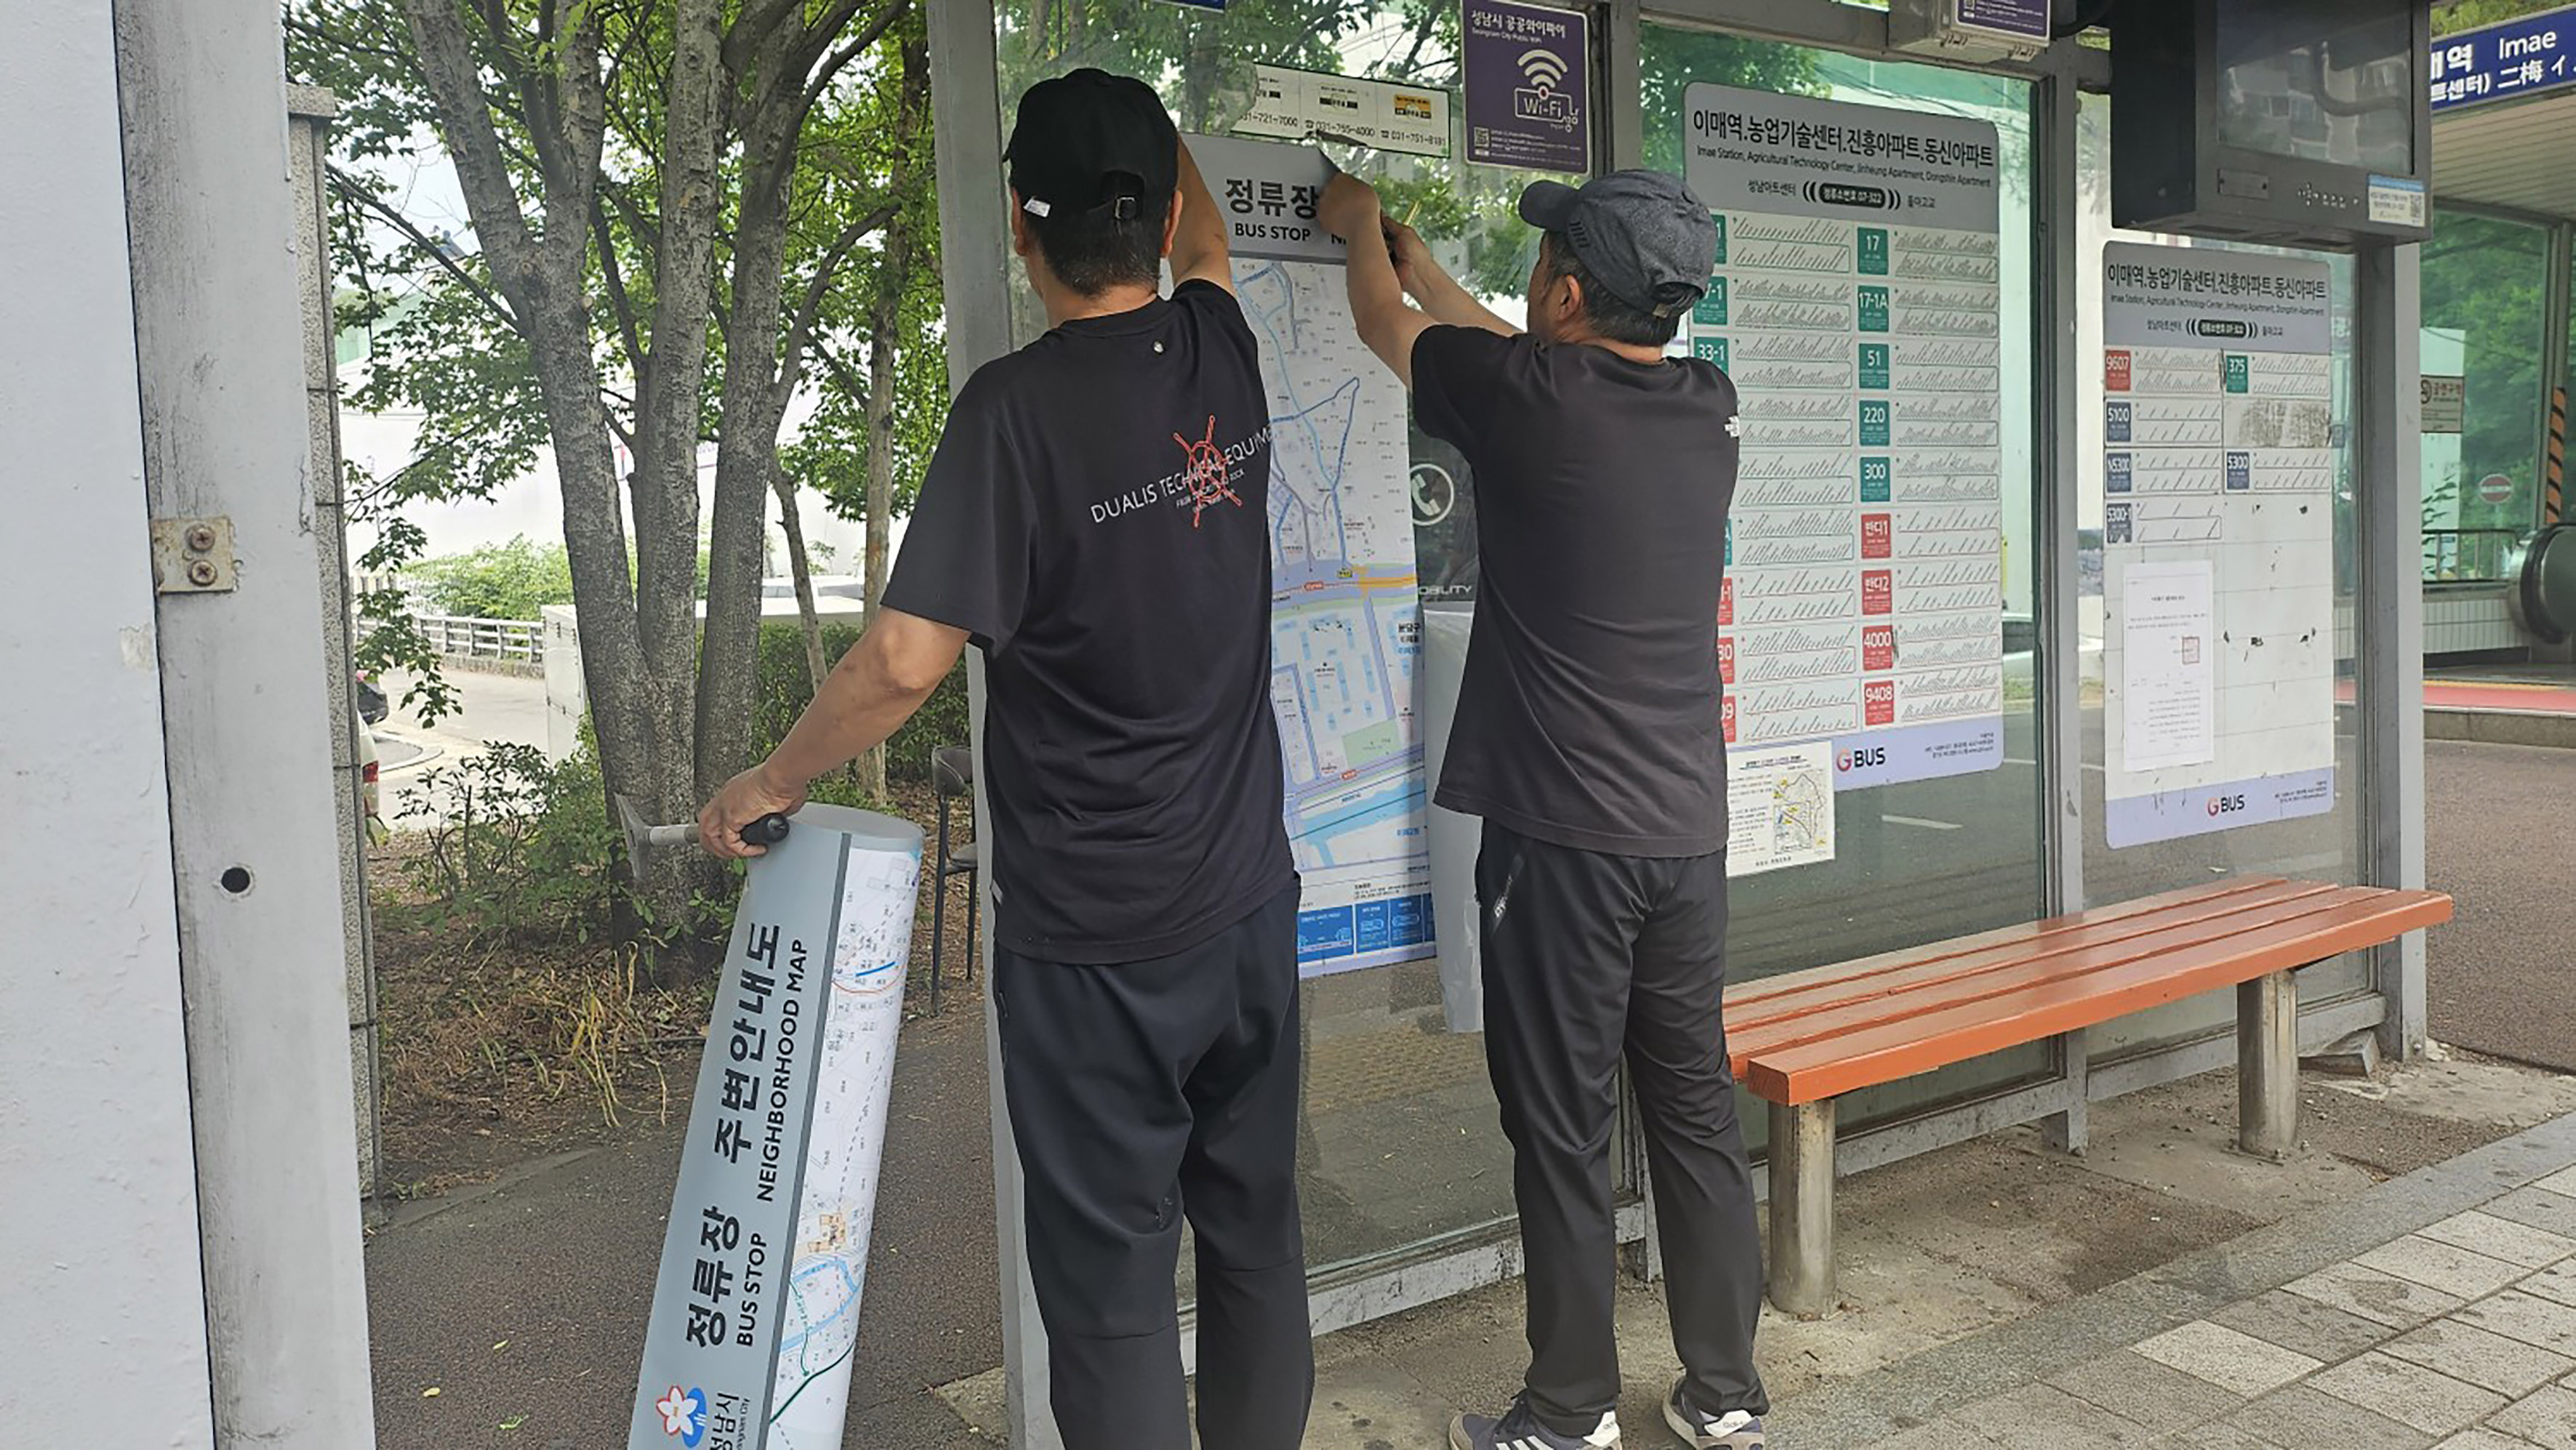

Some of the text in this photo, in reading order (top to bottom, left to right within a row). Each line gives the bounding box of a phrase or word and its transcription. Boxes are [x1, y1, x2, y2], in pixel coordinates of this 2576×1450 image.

[1472, 9, 1566, 39] 성남시 공공와이파이
[2499, 31, 2557, 60] Imae
[2497, 59, 2543, 89] 二梅
[2431, 73, 2490, 102] 트센터)
[1523, 97, 1562, 118] Wi-Fi
[1225, 179, 1320, 220] 정류장
[1235, 222, 1266, 238] BUS
[1270, 226, 1311, 242] STOP
[1866, 235, 1879, 251] 17
[1858, 292, 1887, 308] 17-1A
[1698, 343, 1725, 361] 33-1
[1867, 350, 1881, 366] 51
[1863, 407, 1886, 423] 220
[1864, 464, 1886, 480] 300
[1091, 483, 1157, 523] DUALIS
[1863, 631, 1892, 647] 4000
[1865, 687, 1893, 704] 9408
[686, 922, 781, 1348] 정류장 주변안내도
[737, 938, 809, 1346] BUS STOP NEIGHBORHOOD MAP
